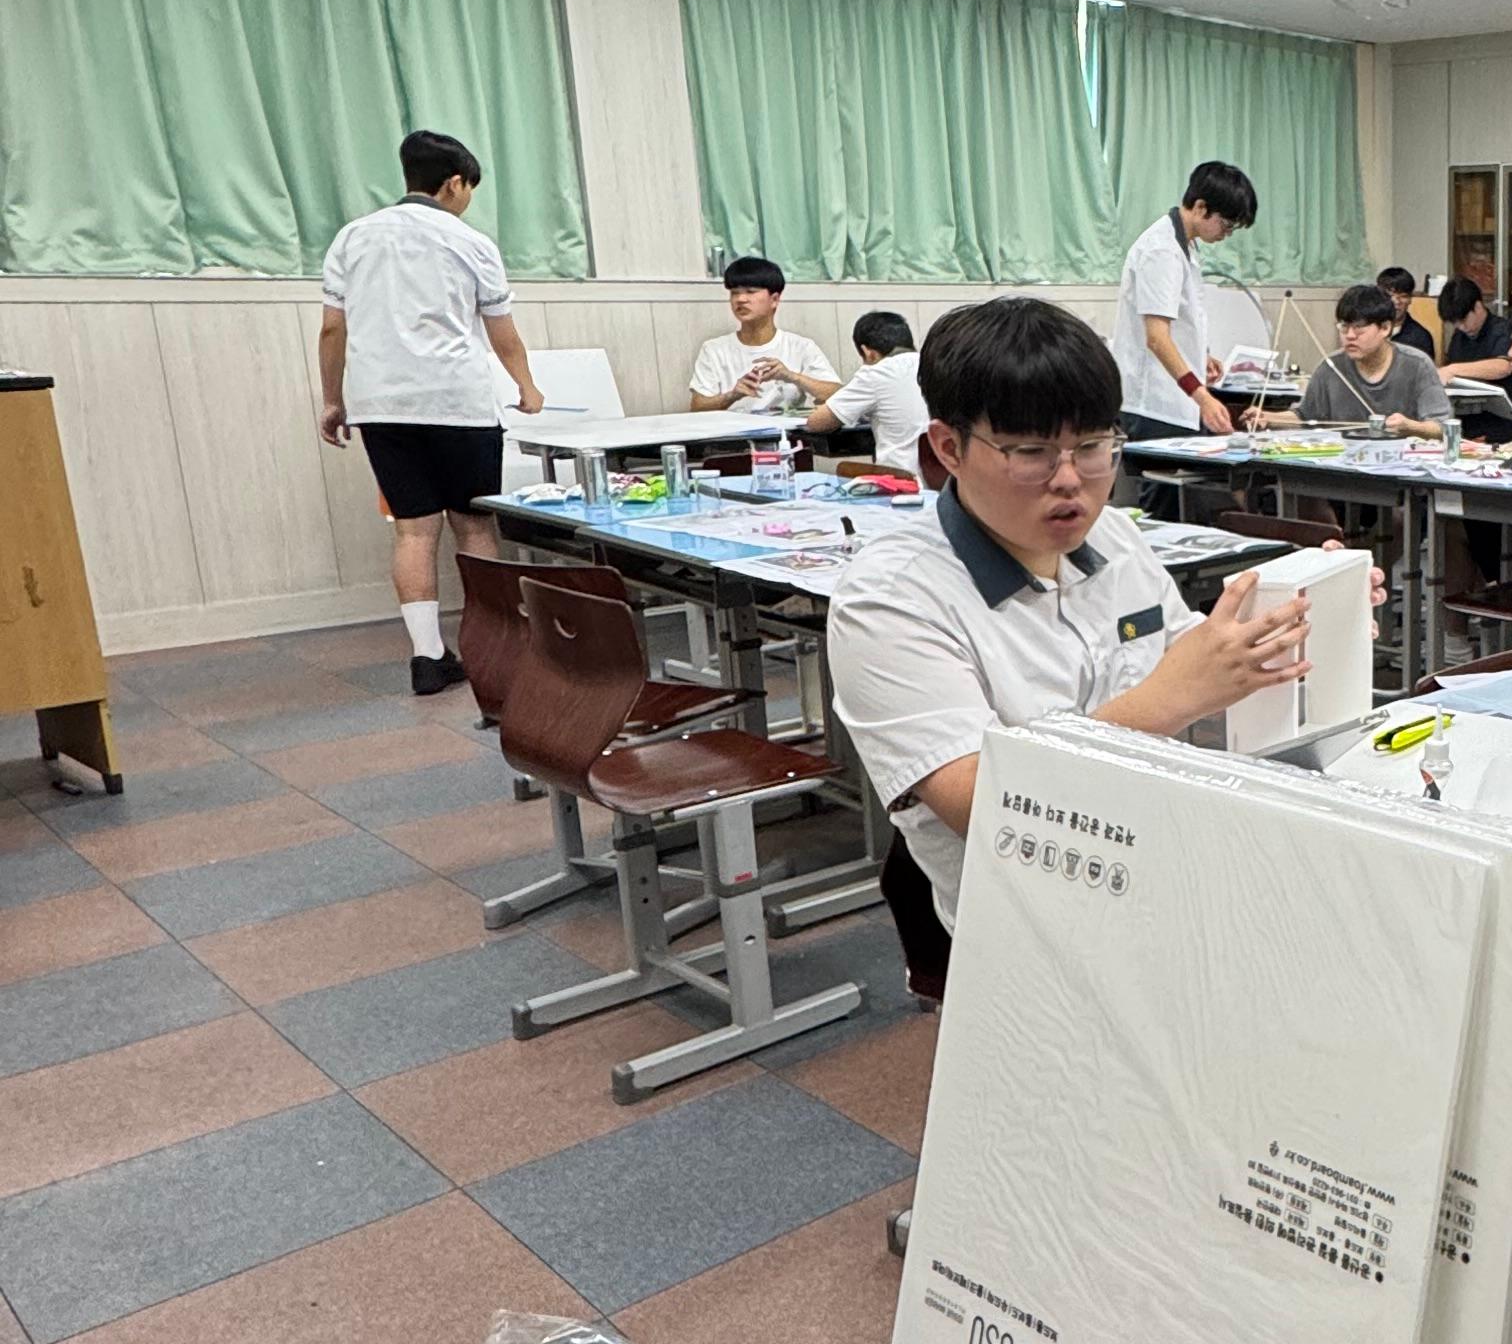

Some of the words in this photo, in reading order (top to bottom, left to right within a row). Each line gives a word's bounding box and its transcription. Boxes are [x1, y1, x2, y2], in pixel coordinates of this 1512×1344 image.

[1002, 791, 1040, 817] 아름답게
[1045, 804, 1065, 825] 보다
[1069, 812, 1100, 836] 공간을
[1103, 822, 1134, 848] 자연과
